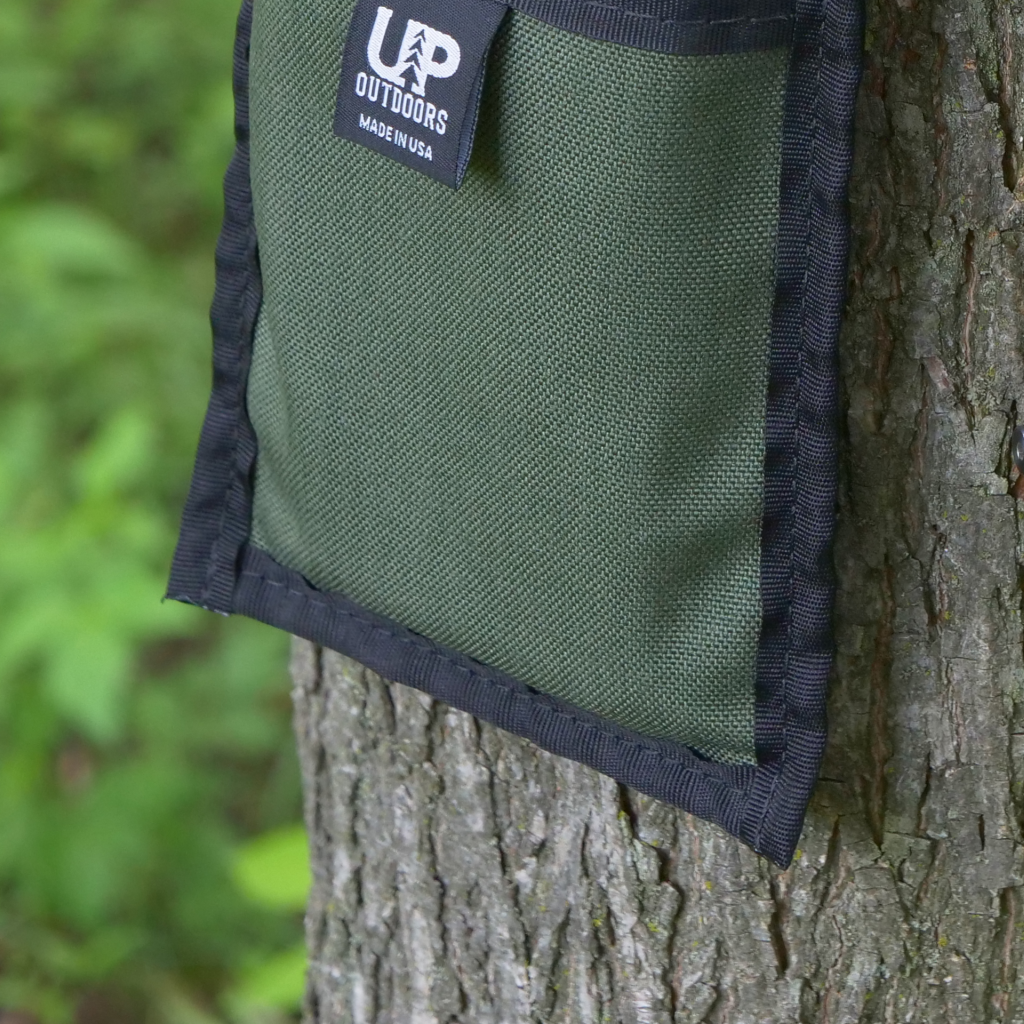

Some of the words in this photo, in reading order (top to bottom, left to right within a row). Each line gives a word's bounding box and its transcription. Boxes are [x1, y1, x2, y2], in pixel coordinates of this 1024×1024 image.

[367, 6, 461, 97] UP
[355, 72, 449, 135] OUTDOORS
[358, 113, 393, 142] MADE
[394, 128, 408, 149] IN
[408, 140, 433, 161] USA
